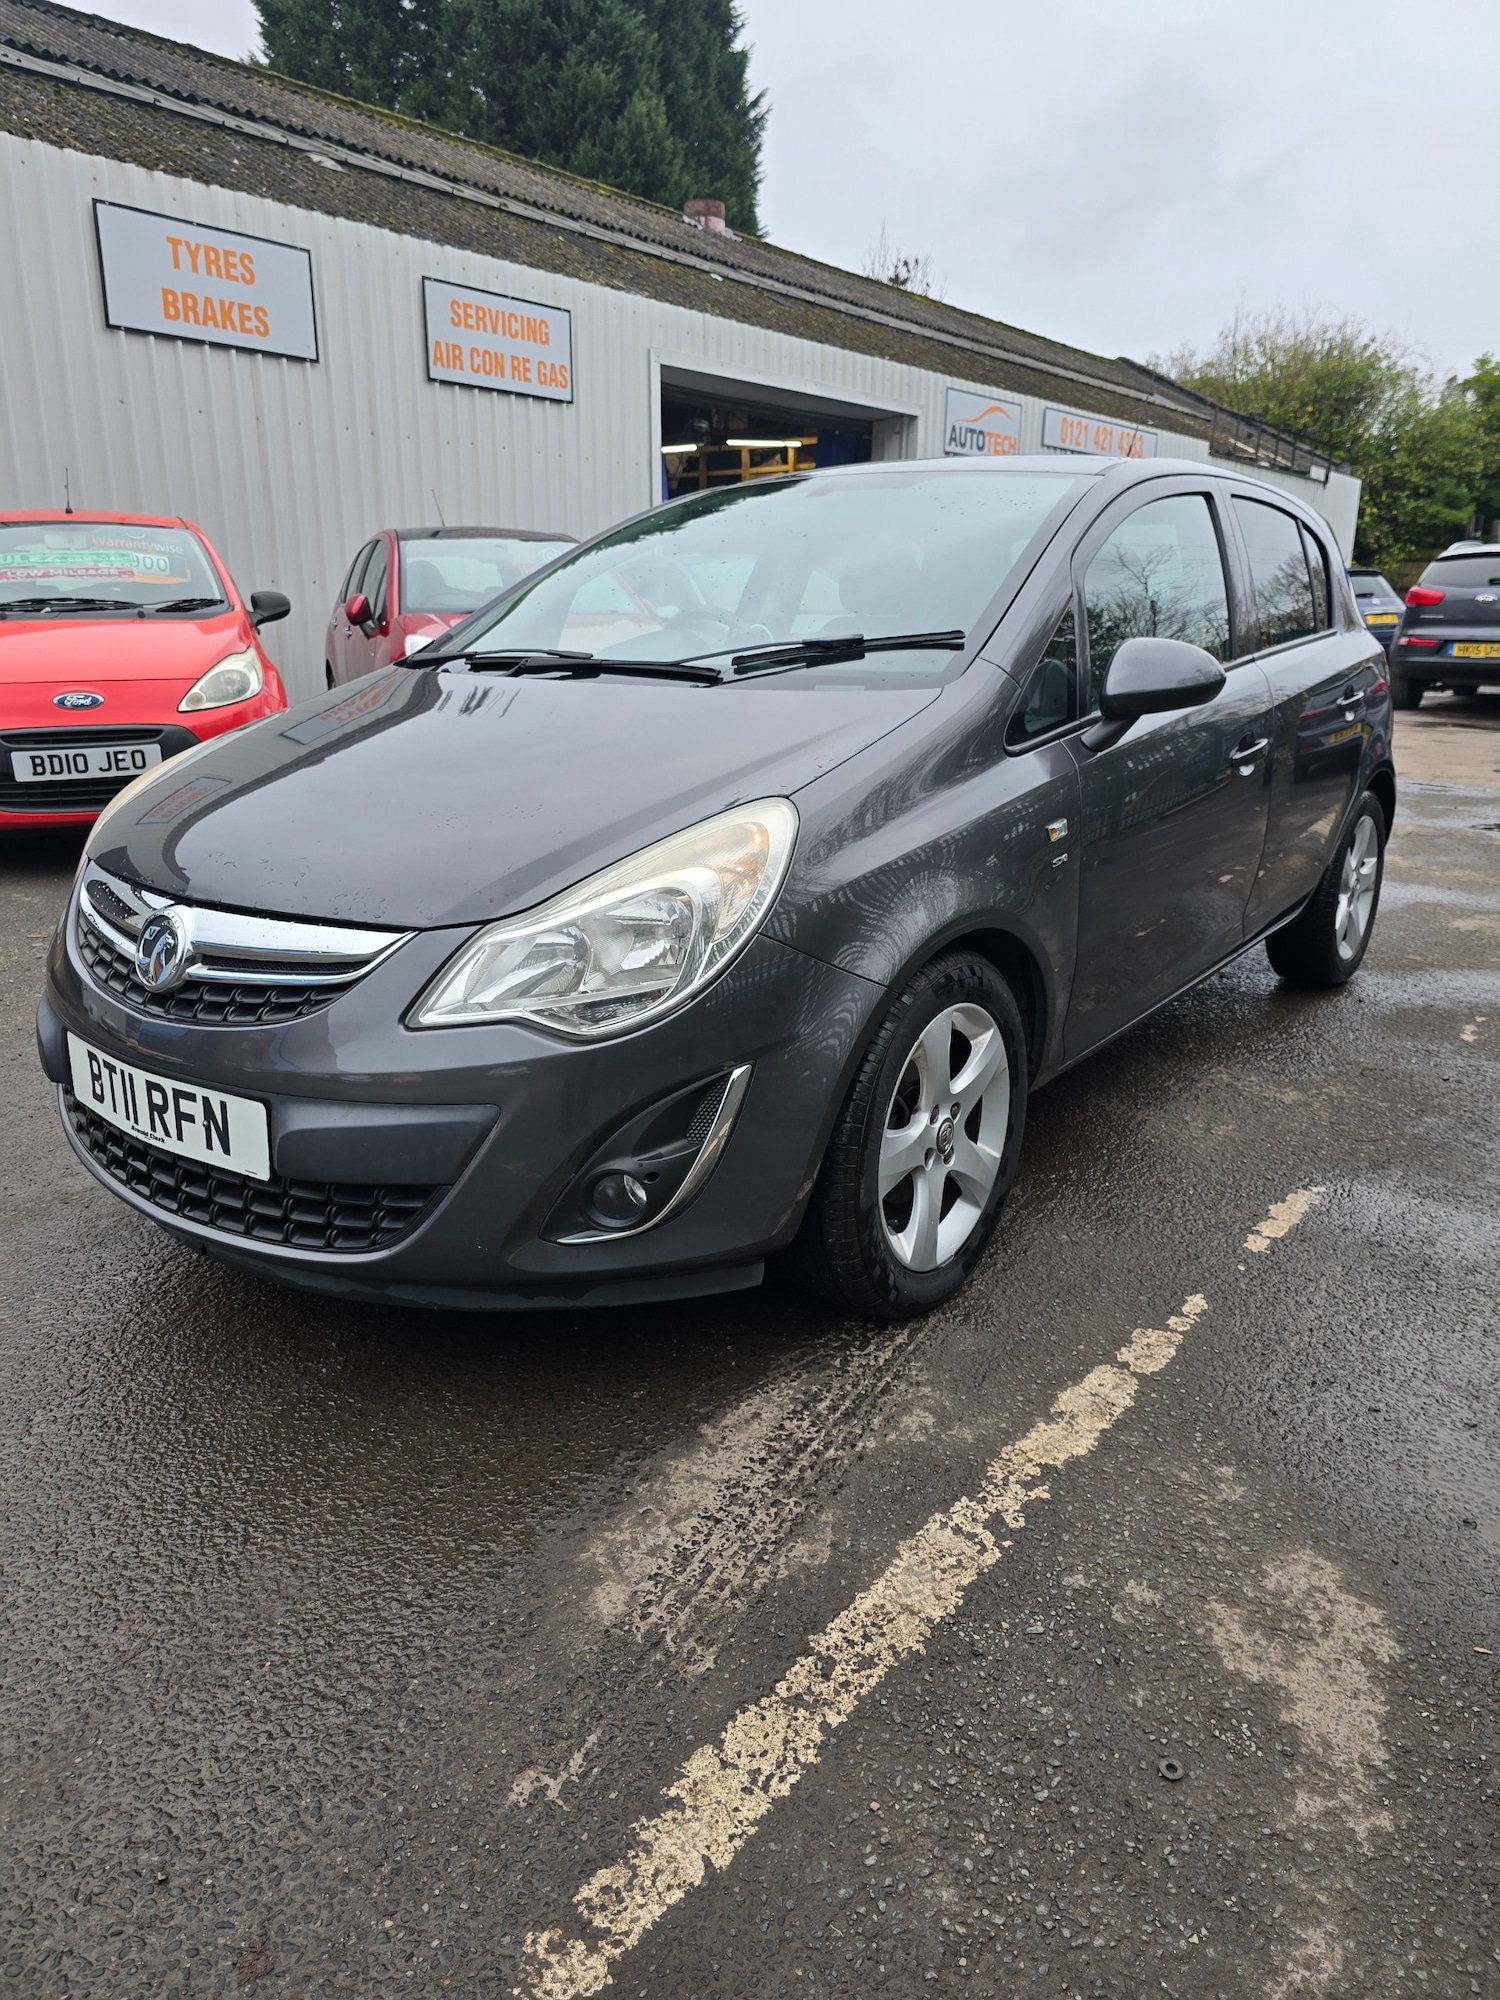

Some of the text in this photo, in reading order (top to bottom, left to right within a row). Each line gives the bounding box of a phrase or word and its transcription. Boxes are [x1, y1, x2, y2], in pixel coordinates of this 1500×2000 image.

[166, 236, 256, 286] TYRES
[161, 288, 270, 338] BRAKES
[450, 299, 550, 346] SERVICING
[432, 340, 569, 390] AIR CON RE GAS
[948, 424, 1017, 455] AUTOTECH
[1060, 416, 1089, 448] 0121
[1093, 425, 1114, 453] 421
[92, 535, 183, 555] Warrantywise
[7, 569, 44, 579] LOW
[64, 694, 93, 707] Ford
[29, 749, 147, 776] BD10 JEO
[87, 1049, 231, 1156] BT11 RFN
